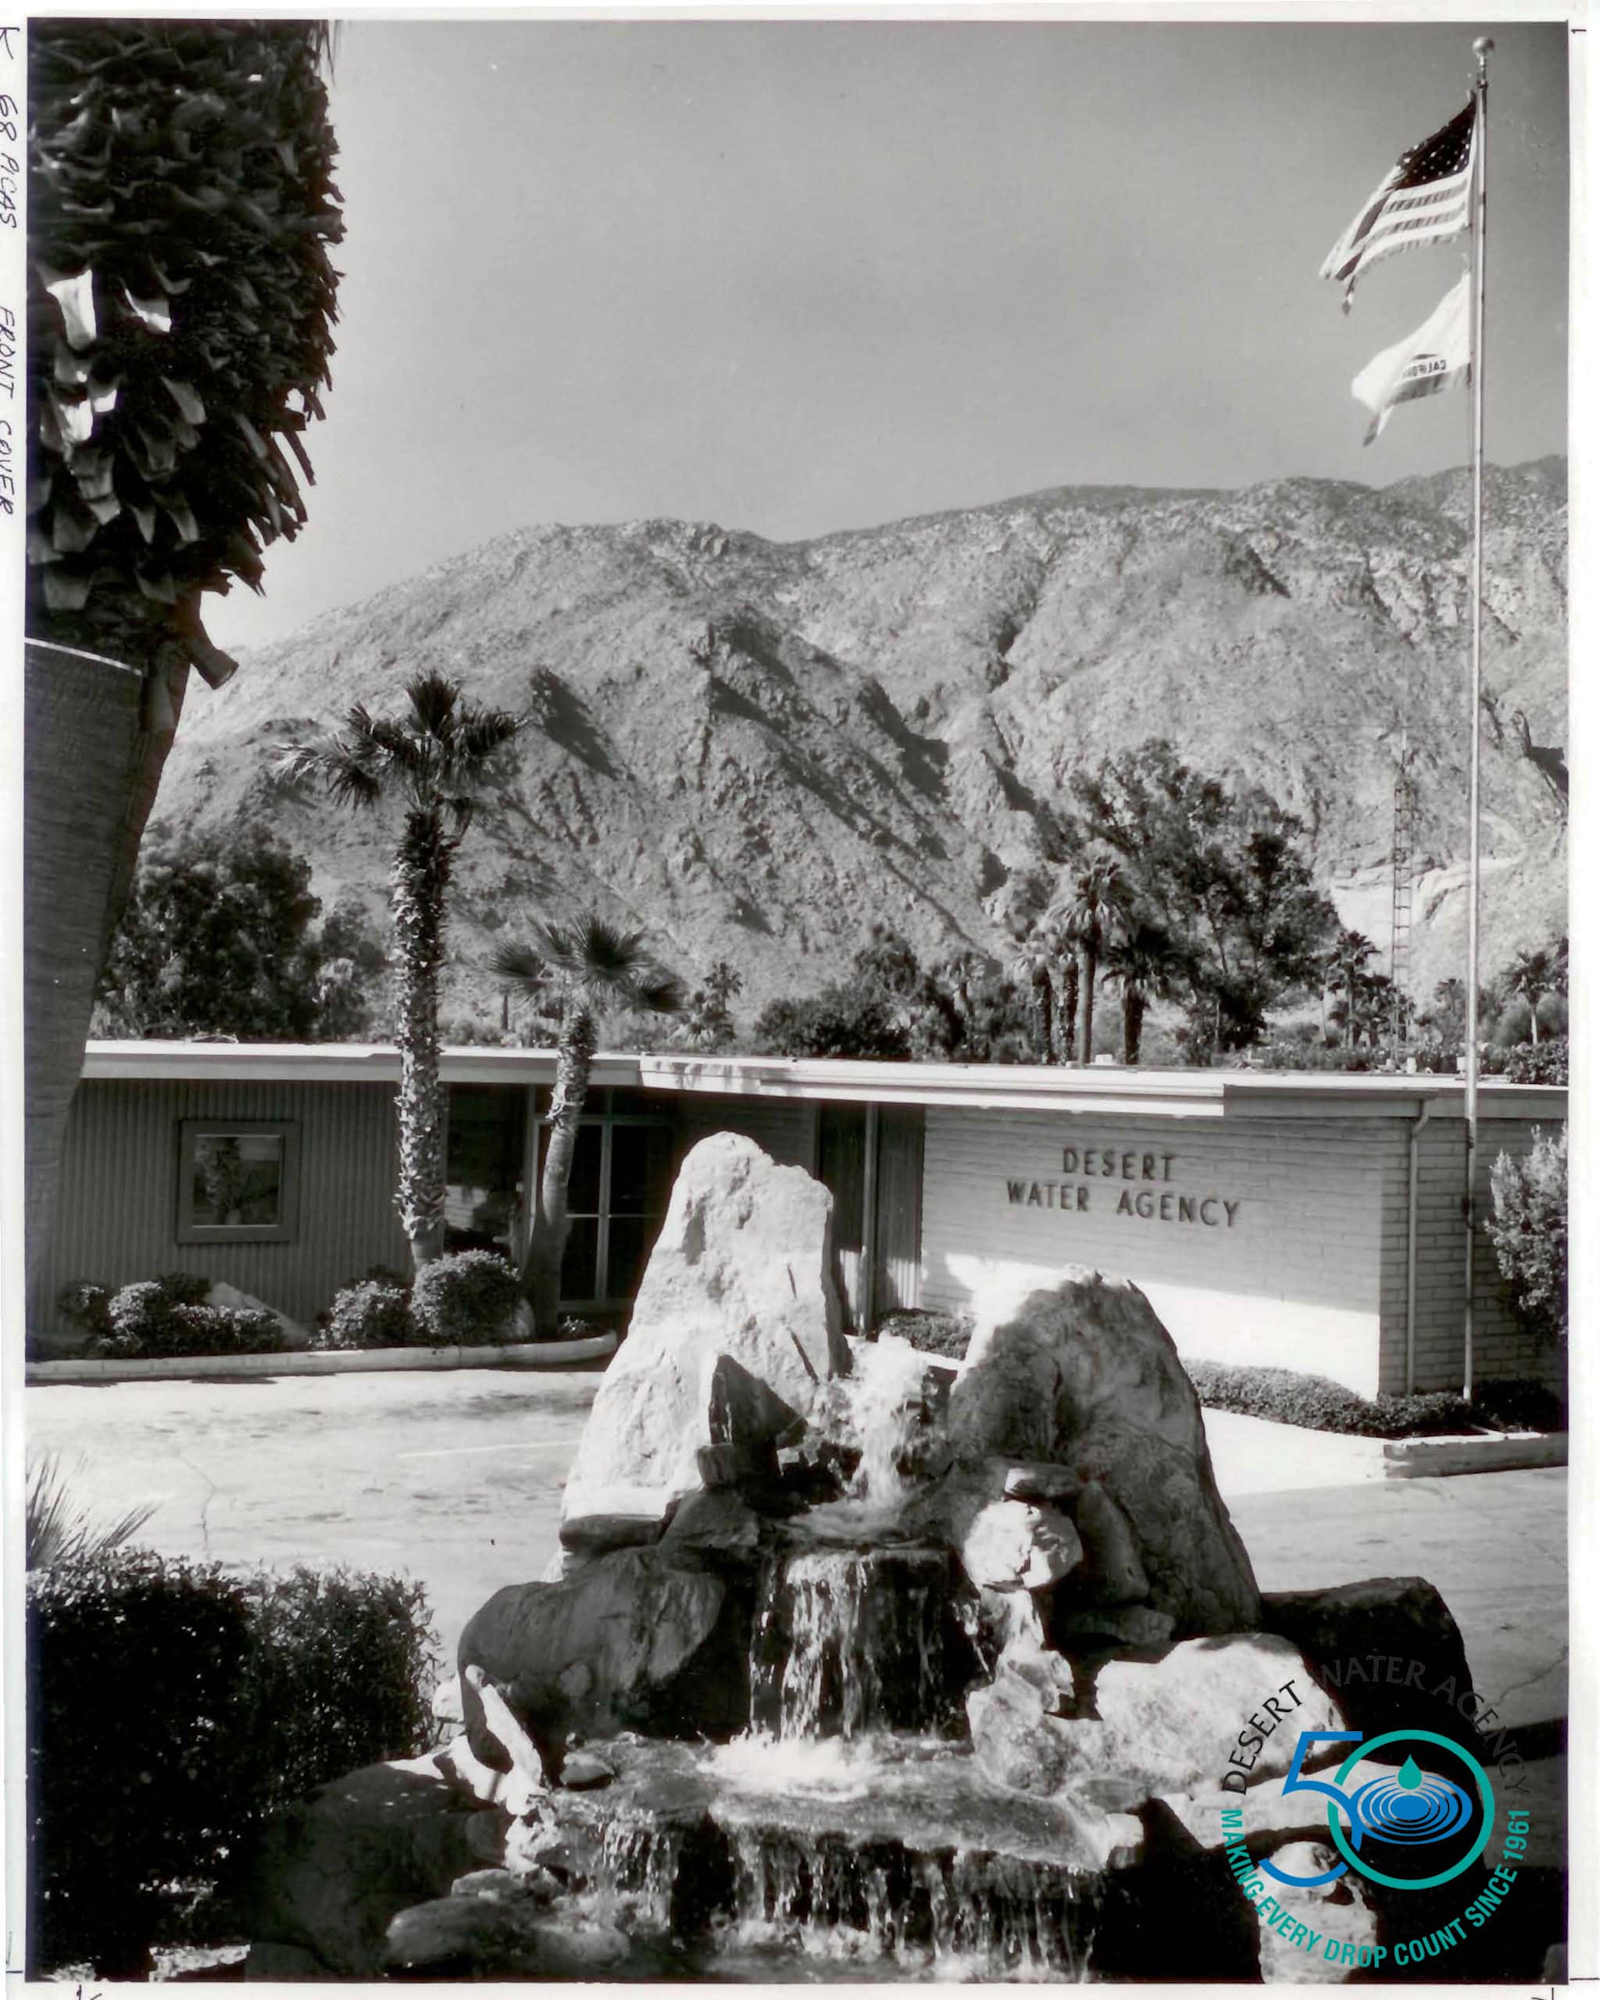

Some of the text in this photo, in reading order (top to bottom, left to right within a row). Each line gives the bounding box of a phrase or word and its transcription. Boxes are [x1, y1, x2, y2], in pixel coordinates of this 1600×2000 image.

[0, 94, 18, 141] 68
[0, 306, 16, 516] FRONT COVER
[1063, 1147, 1175, 1182] DESERT
[1006, 1180, 1241, 1227] WATER AGENCY
